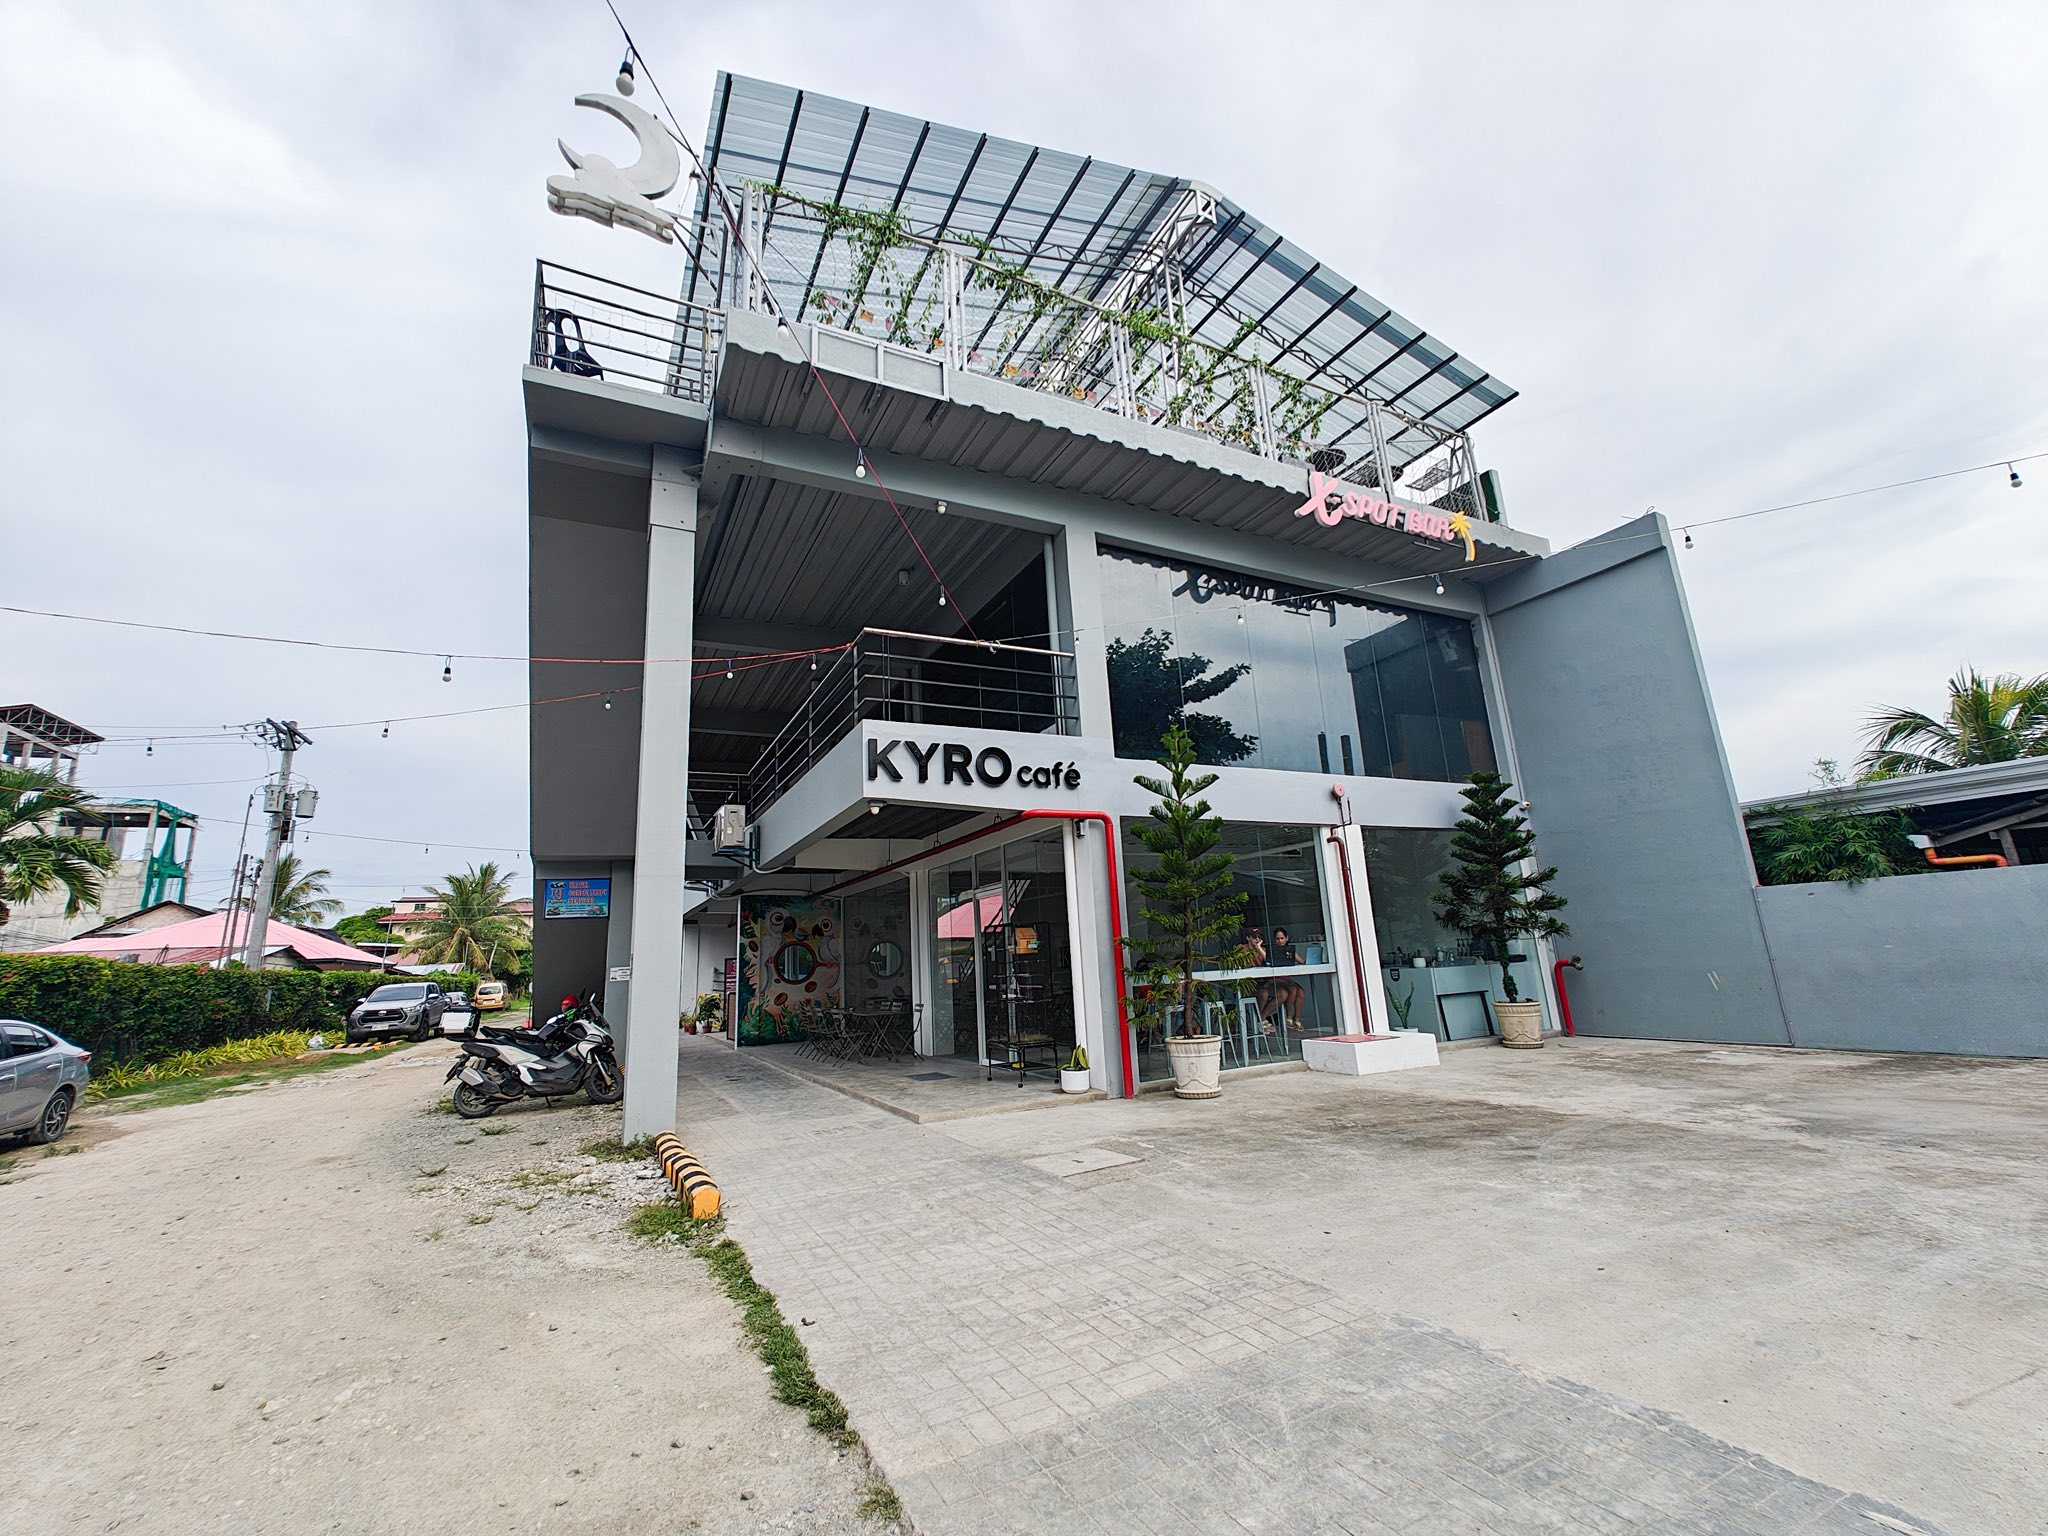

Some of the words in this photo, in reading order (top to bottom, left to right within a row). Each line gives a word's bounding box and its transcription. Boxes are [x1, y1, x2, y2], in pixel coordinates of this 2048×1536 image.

[1408, 508, 1455, 543] BAR
[867, 738, 1012, 787] KYRO
[1016, 761, 1081, 789] café
